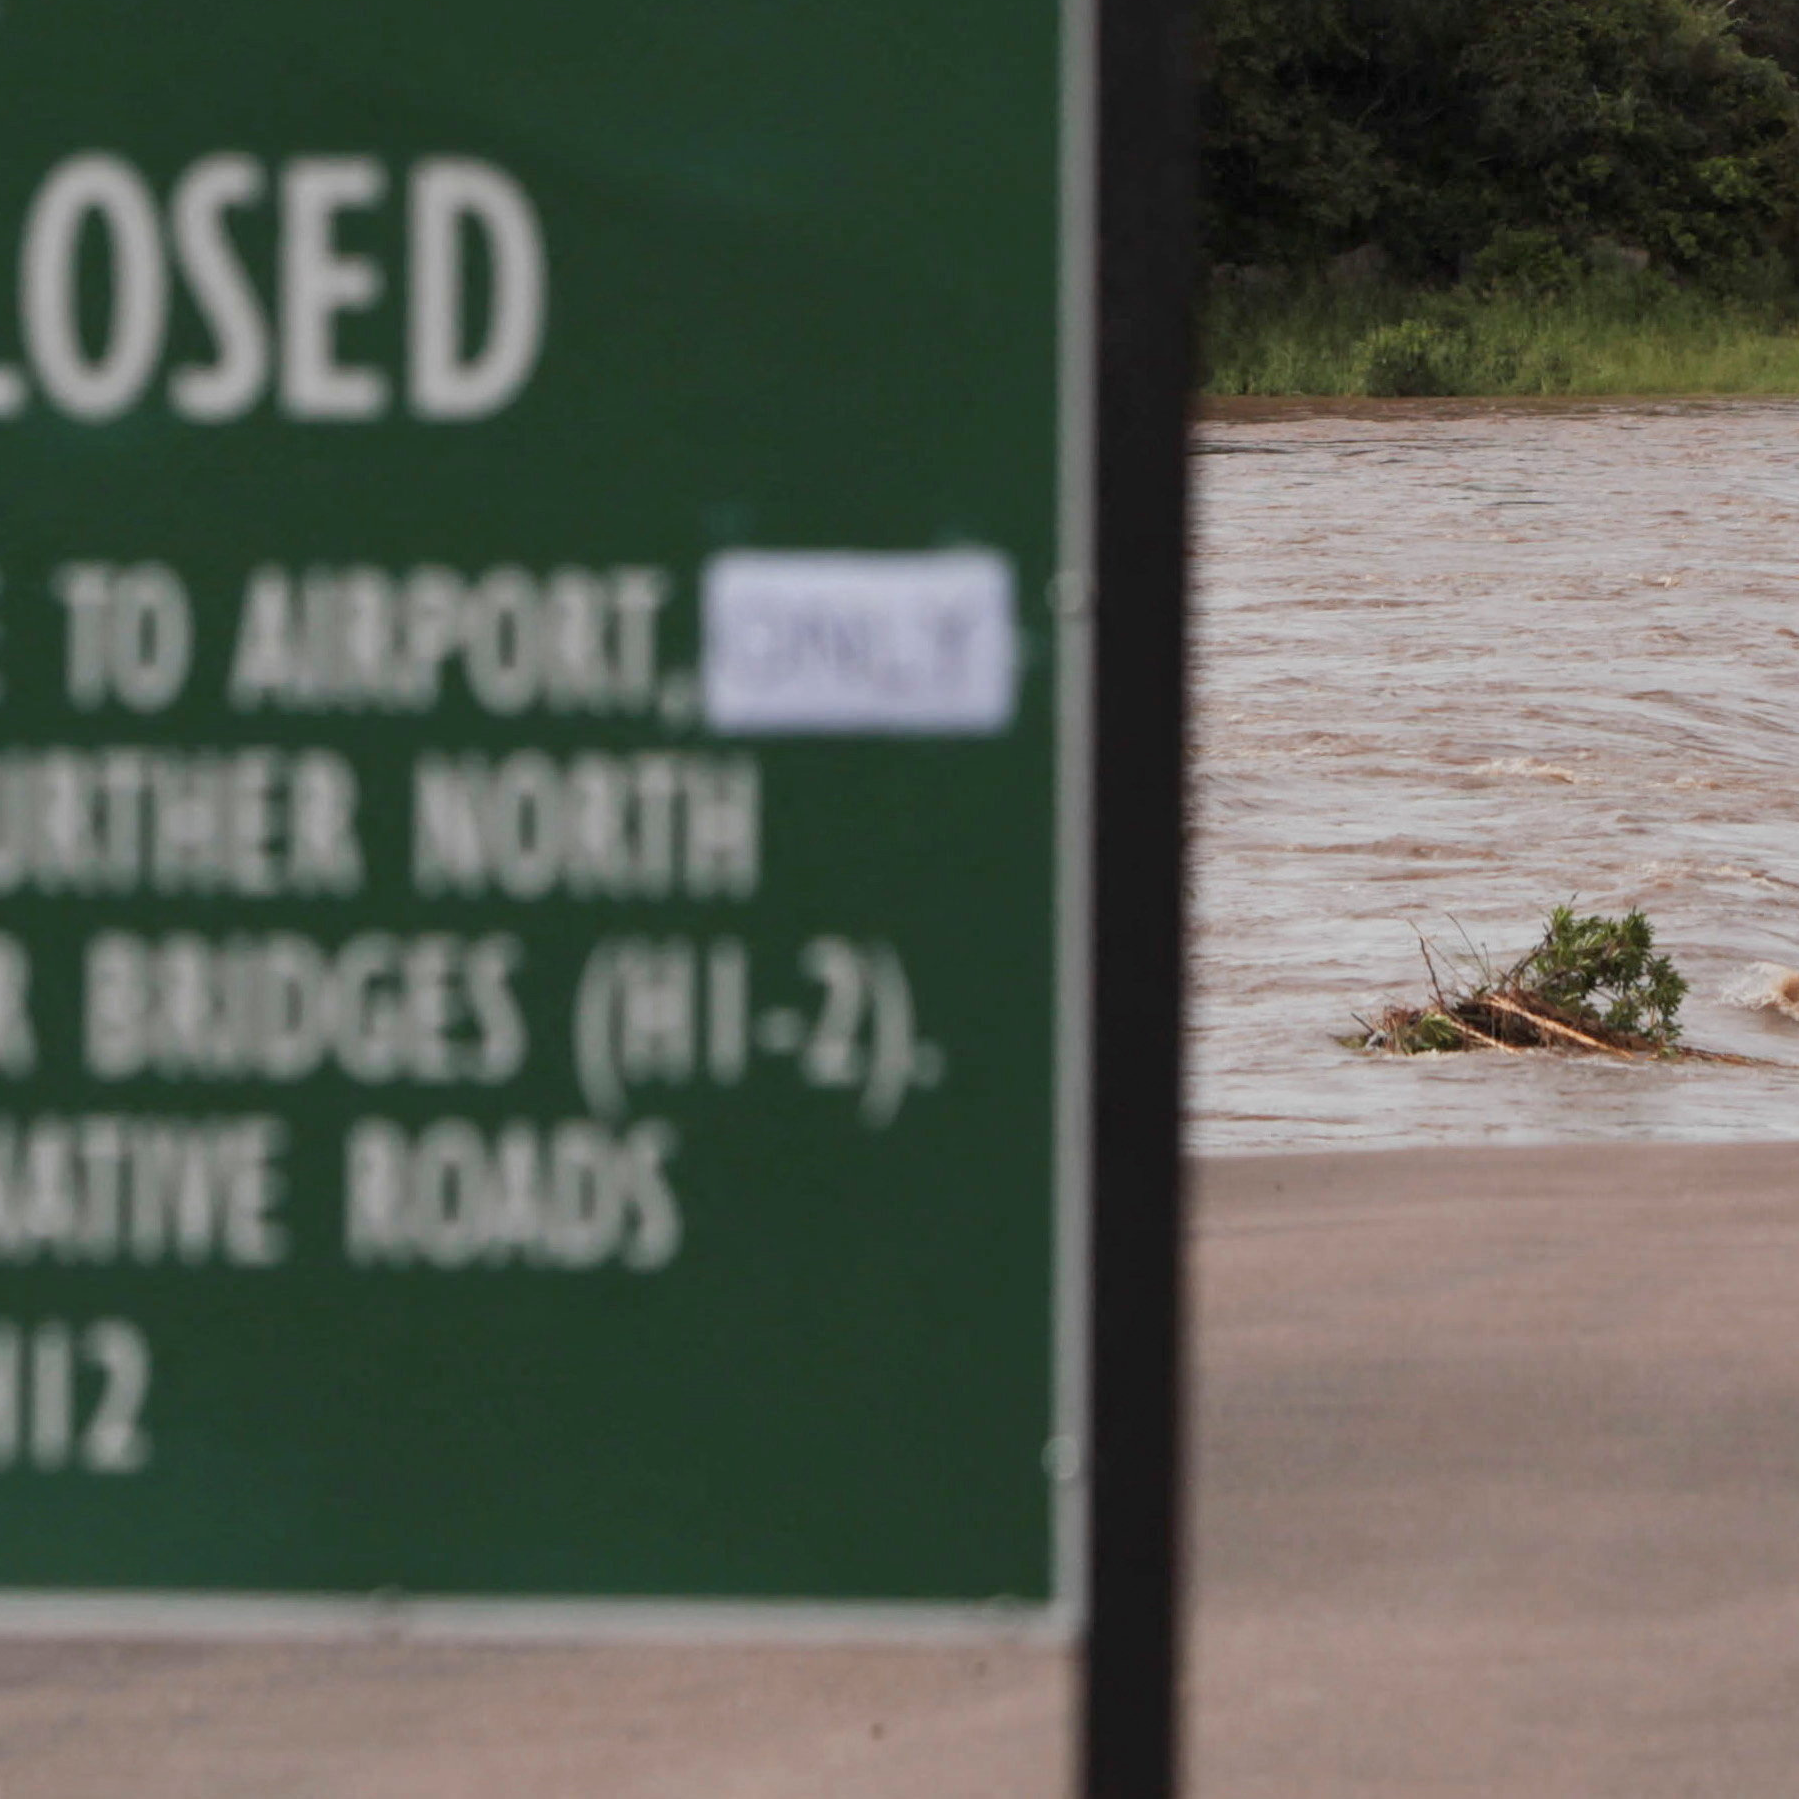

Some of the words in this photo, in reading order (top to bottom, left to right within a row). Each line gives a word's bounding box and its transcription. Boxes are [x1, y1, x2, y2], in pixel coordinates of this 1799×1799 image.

[56, 563, 193, 709] TO
[412, 749, 761, 898] NORTH
[81, 933, 527, 1083] BRIDGES
[342, 1119, 684, 1269] ROADS
